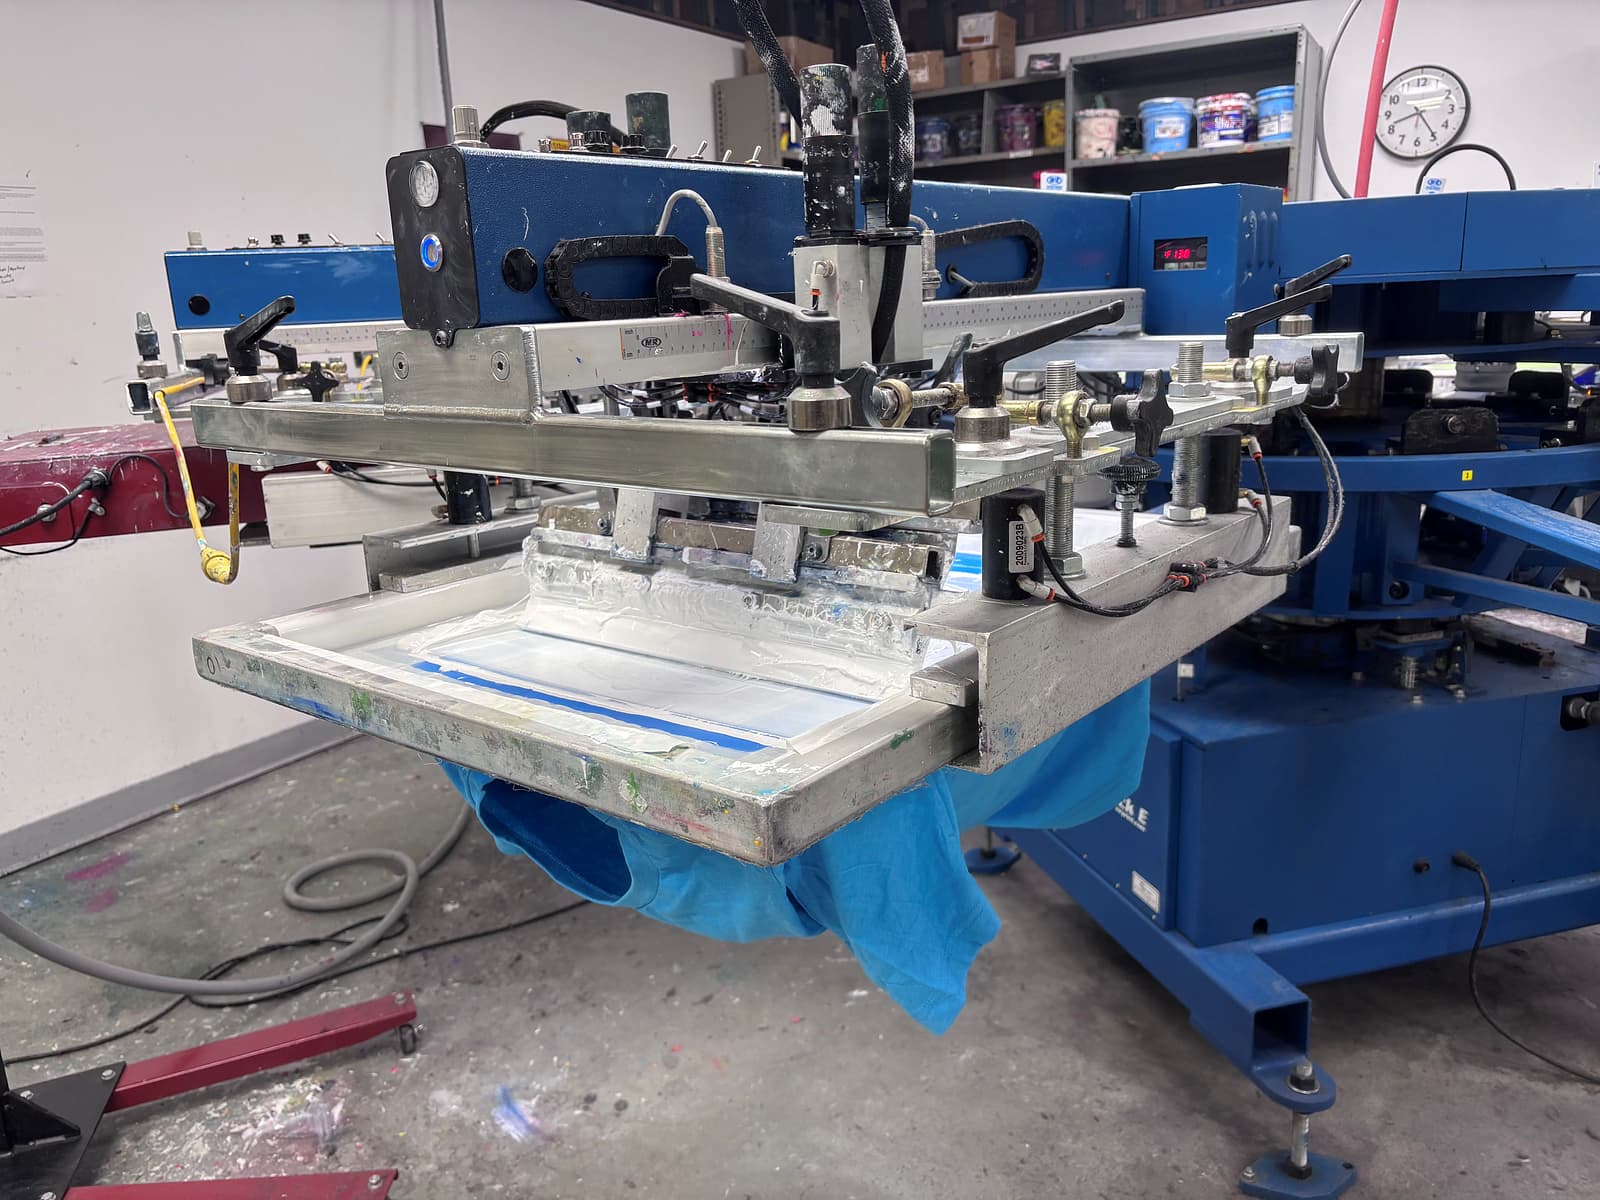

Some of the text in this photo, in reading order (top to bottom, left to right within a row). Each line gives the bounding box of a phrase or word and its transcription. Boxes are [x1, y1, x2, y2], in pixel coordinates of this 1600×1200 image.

[1416, 77, 1428, 87] 12
[1389, 94, 1400, 105] 10
[1444, 89, 1452, 100] 2
[1447, 103, 1455, 114] 3
[1384, 110, 1392, 120] 9
[1387, 124, 1395, 135] 8
[1441, 119, 1449, 129] 4
[1399, 134, 1406, 145] 7
[1413, 137, 1421, 147] 6
[1429, 131, 1437, 142] 5
[1016, 523, 1024, 566] 2009023B
